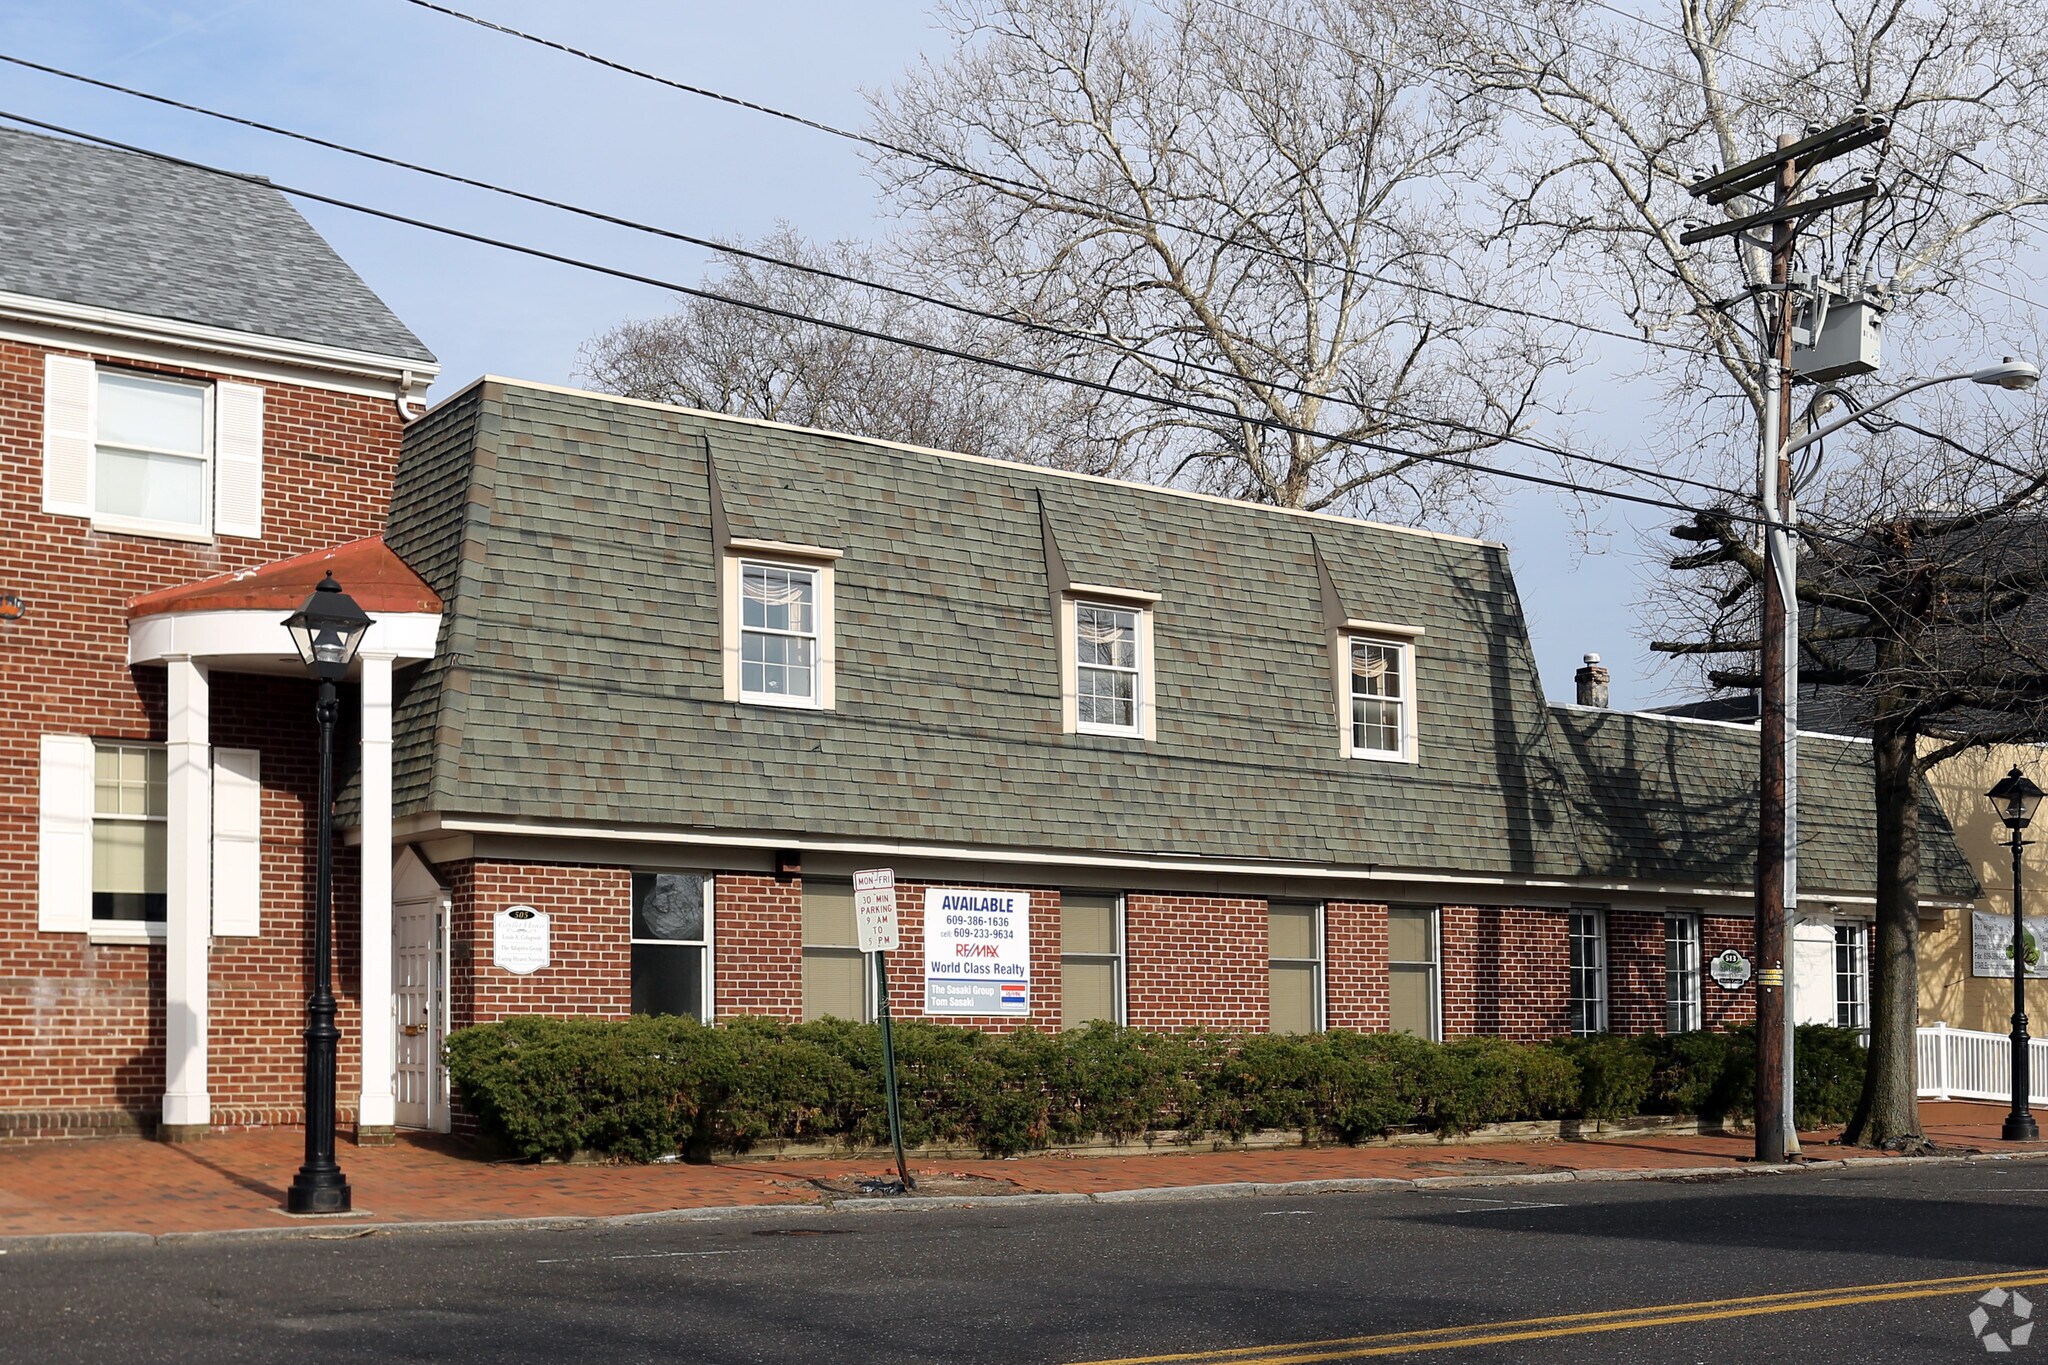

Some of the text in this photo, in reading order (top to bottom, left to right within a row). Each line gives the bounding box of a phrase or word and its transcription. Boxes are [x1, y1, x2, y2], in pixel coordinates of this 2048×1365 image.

[858, 876, 890, 886] MON-FRI
[862, 895, 889, 904] 30 MIN
[942, 896, 1013, 913] AVAILABLE
[861, 904, 892, 915] PARKING
[946, 915, 1009, 927] 609-386-1636
[873, 926, 883, 934] TO
[954, 928, 1014, 939] 609-233-9634
[878, 936, 890, 944] PM
[956, 943, 999, 958] RE/MAX
[931, 961, 1024, 977] World Class Realty
[931, 985, 995, 996] The Sasaki Group
[931, 997, 974, 1007] Tom Sasaki
